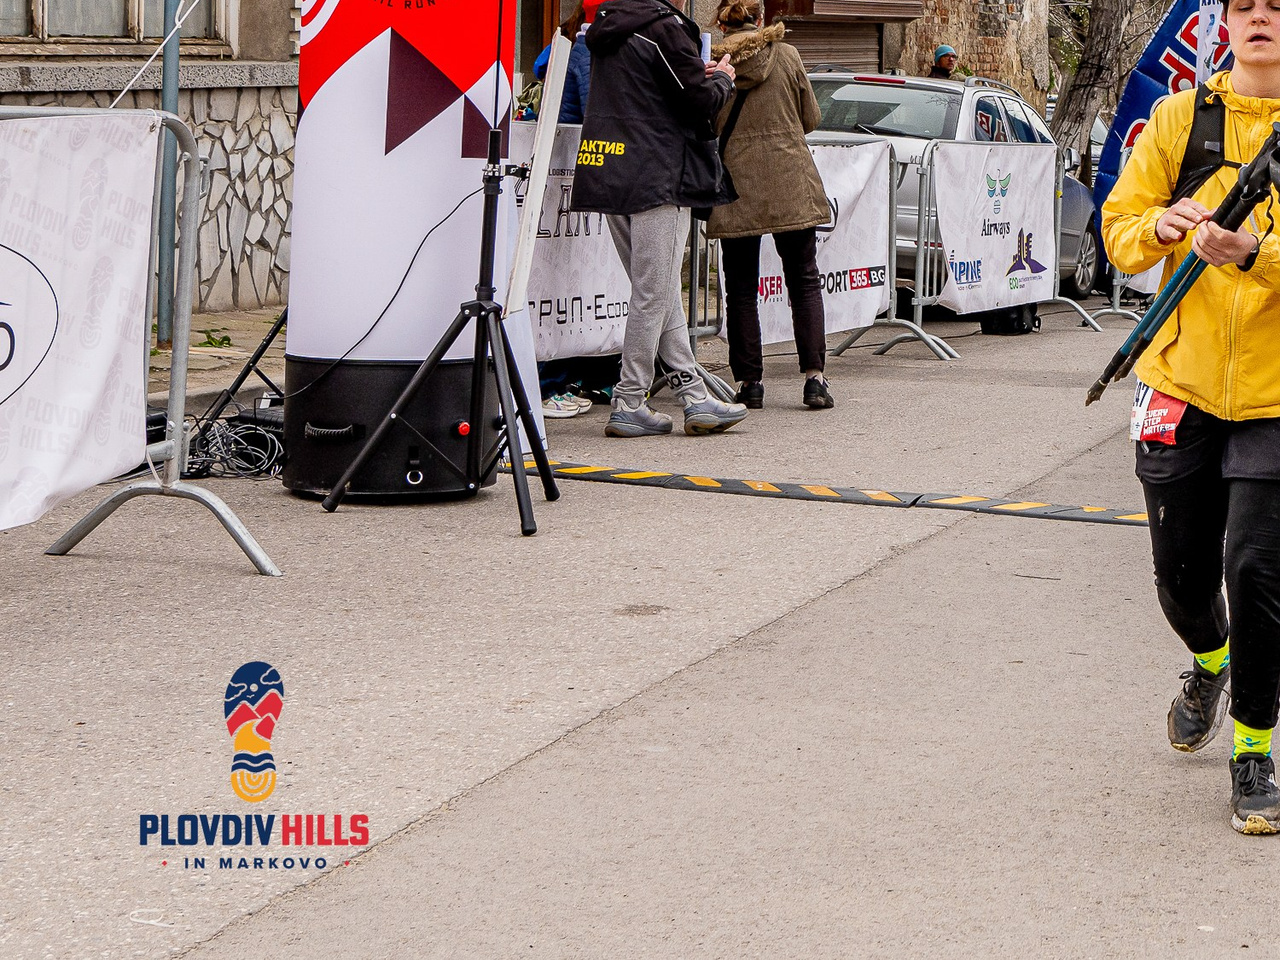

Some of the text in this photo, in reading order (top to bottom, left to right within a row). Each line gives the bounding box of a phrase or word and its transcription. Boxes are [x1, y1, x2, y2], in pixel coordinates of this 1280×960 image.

[580, 139, 625, 155] АКТИВ
[577, 152, 604, 166] 2013
[981, 218, 1010, 239] Airways
